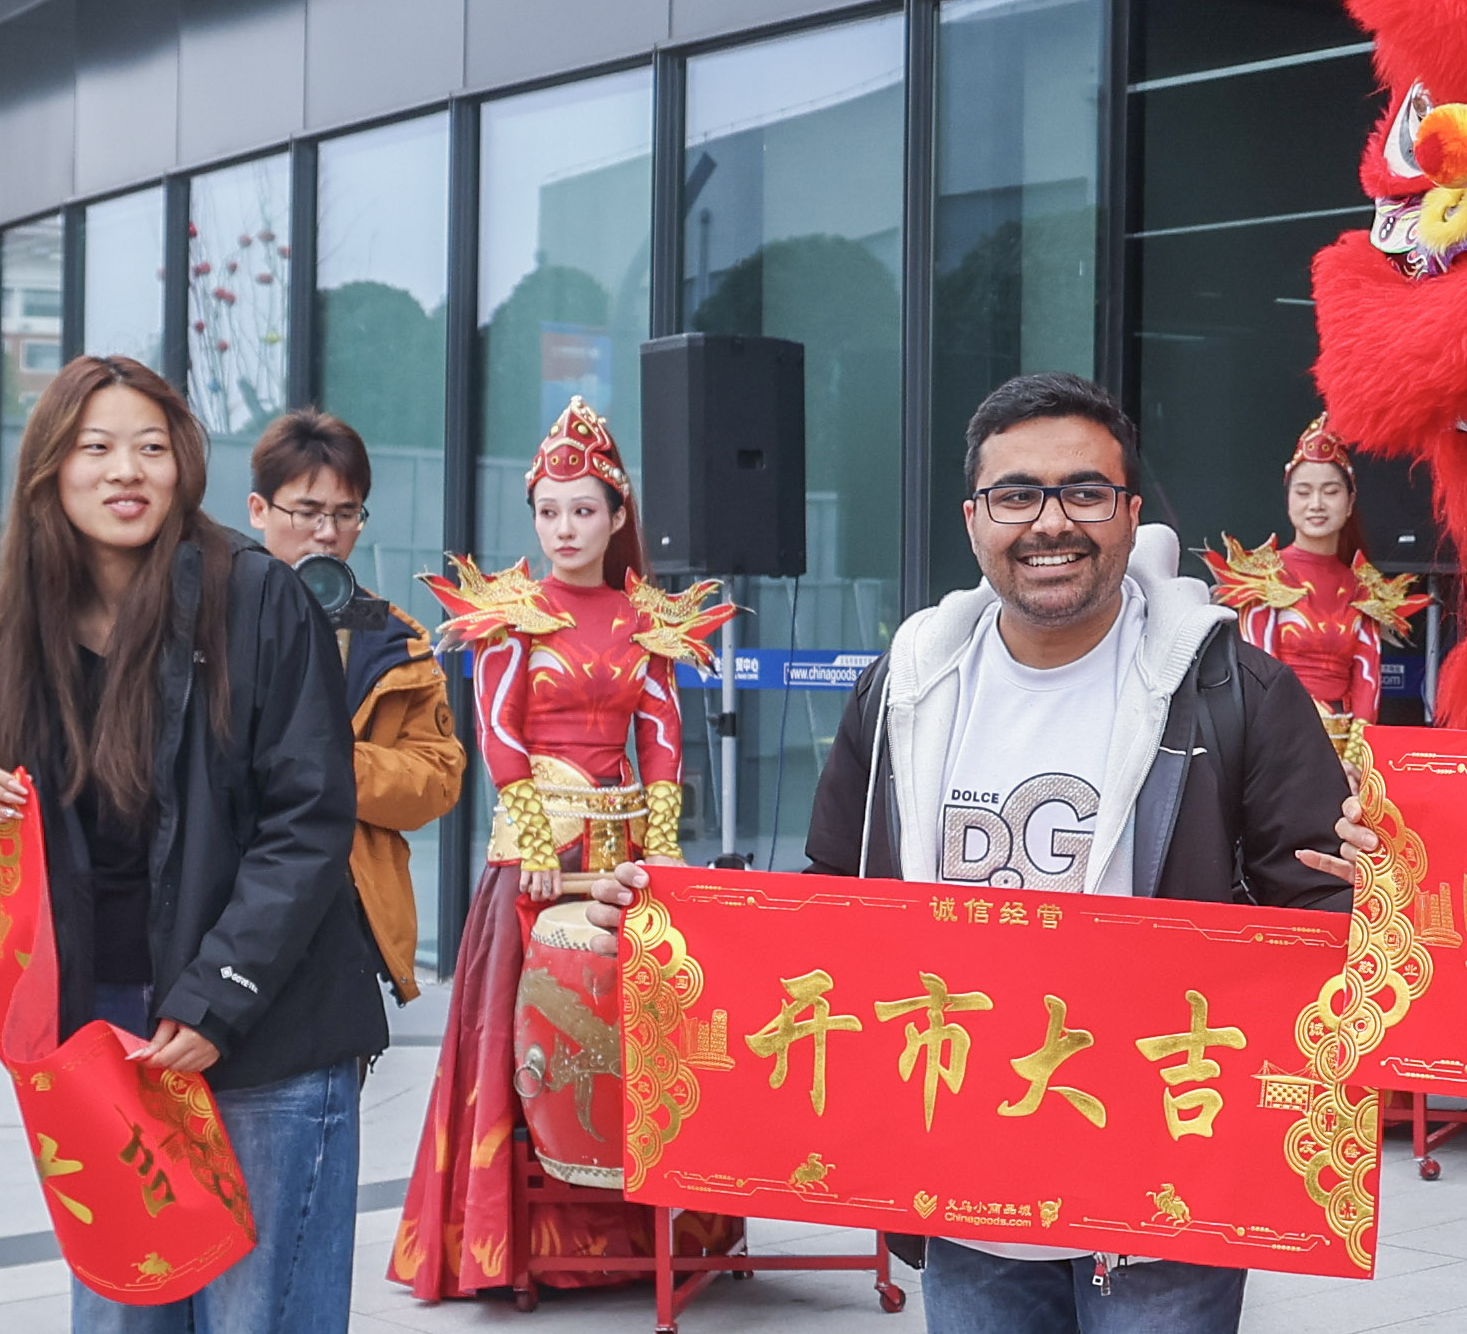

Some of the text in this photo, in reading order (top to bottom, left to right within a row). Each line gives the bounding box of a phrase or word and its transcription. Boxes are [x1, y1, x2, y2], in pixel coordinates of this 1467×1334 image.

[951, 789, 1000, 804] DOLCE
[929, 896, 1063, 929] 诚信经营
[744, 968, 1247, 1141] 开市大吉
[944, 1212, 1032, 1227] Chinagoods.com
